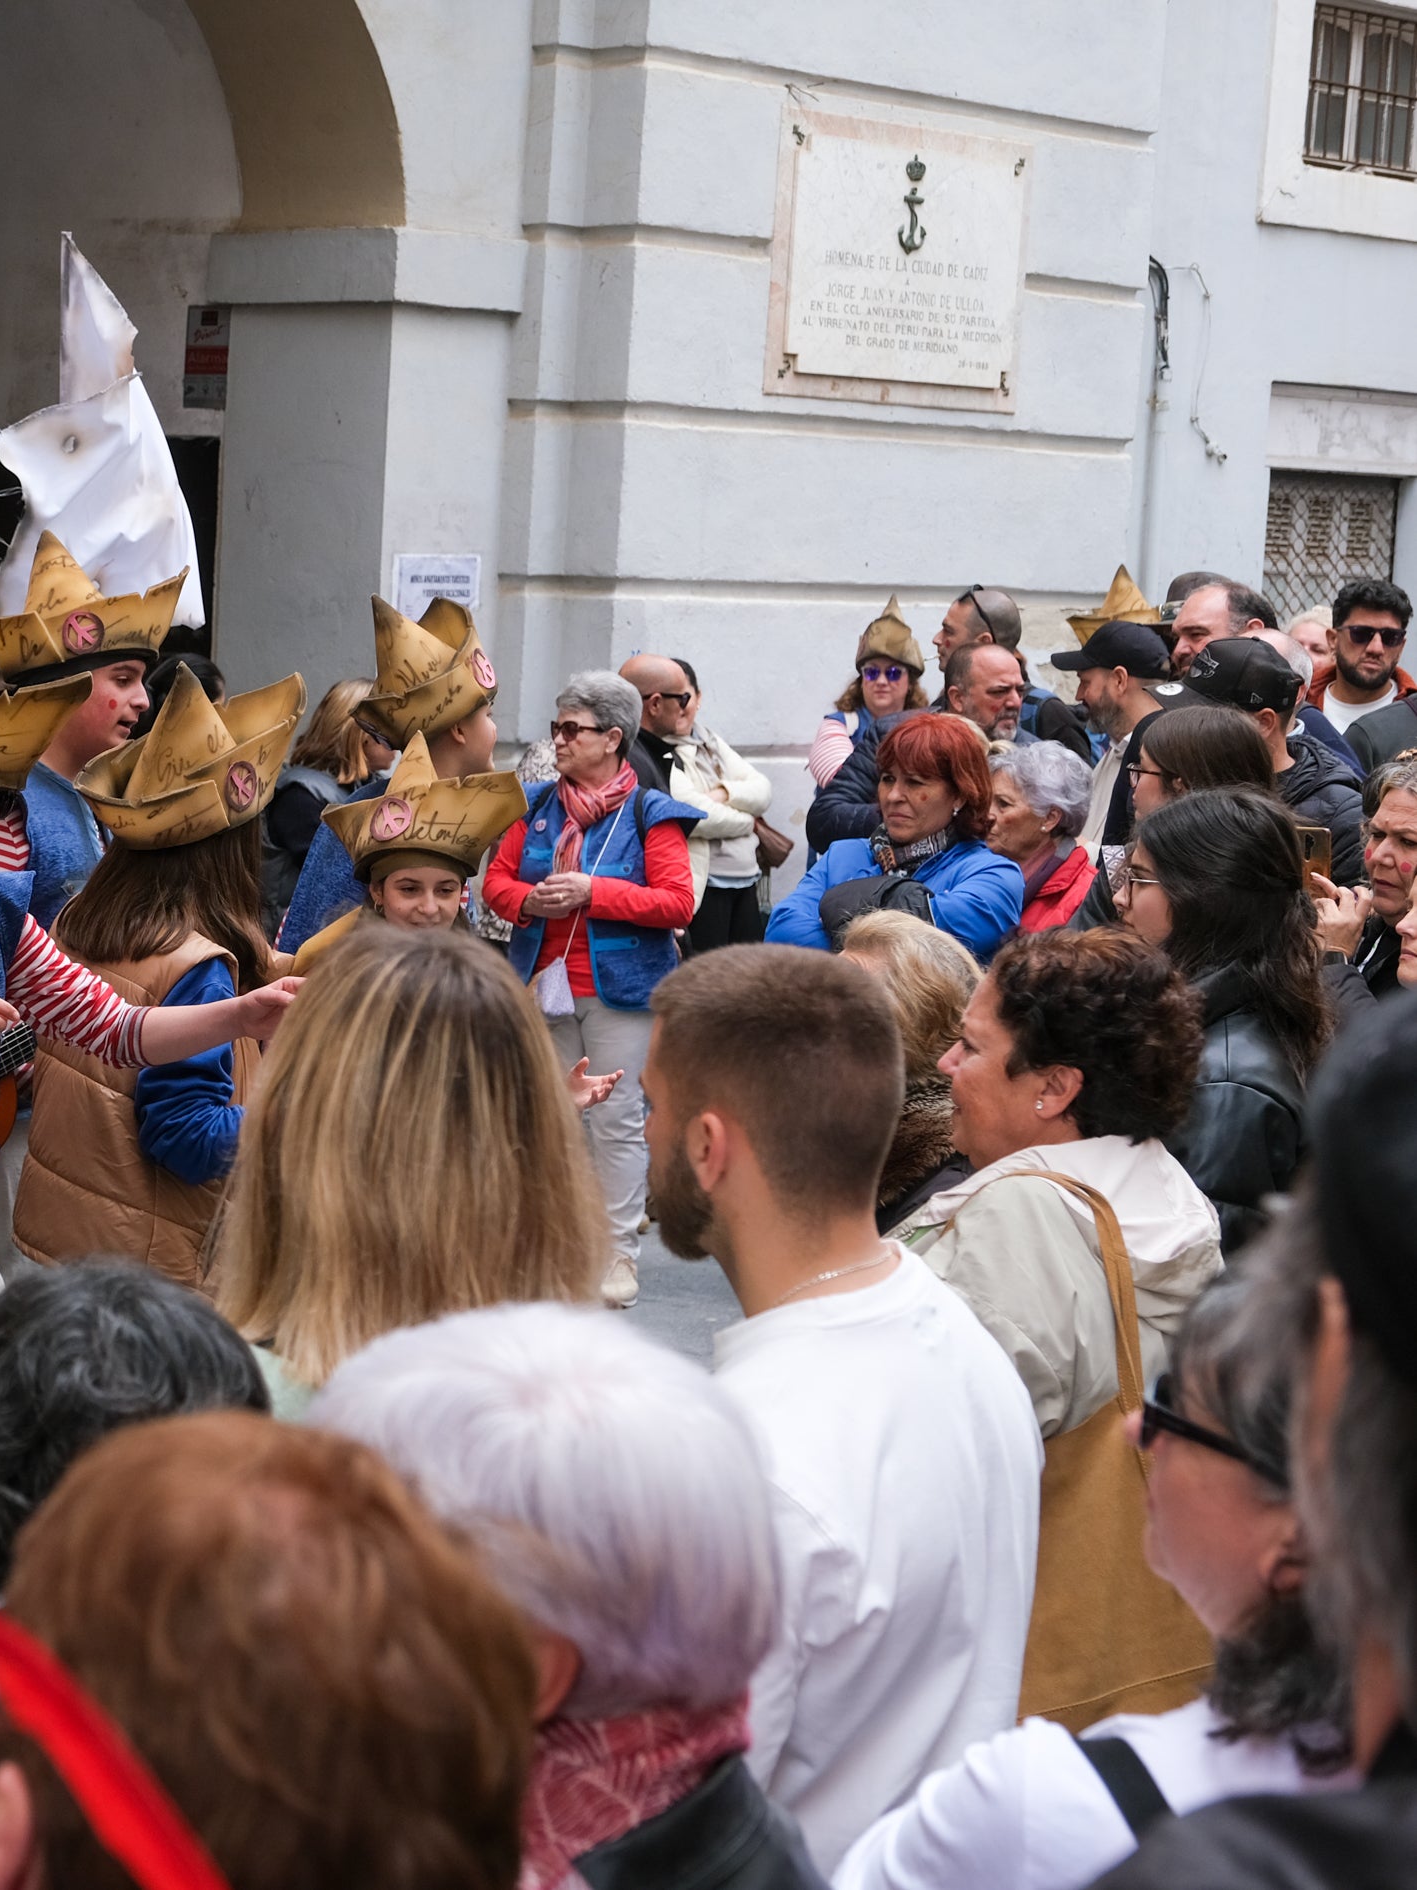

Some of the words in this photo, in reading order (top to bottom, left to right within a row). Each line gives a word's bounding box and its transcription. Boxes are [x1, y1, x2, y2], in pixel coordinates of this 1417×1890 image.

[825, 250, 875, 269] HOMENAJE
[879, 255, 892, 271] DE
[895, 256, 908, 273] LA
[912, 259, 944, 276] CIUDAD
[947, 263, 959, 278] DE
[826, 282, 856, 300] JORGE
[860, 286, 884, 302] JUAN
[888, 289, 895, 303] Y
[898, 291, 936, 308] ANTONIO
[940, 294, 952, 310] DE
[955, 296, 984, 313] ULLOA
[802, 316, 813, 327] AL
[873, 321, 891, 334] DEL
[922, 325, 944, 338] PARA
[947, 329, 959, 340] LA
[810, 300, 823, 311] EN
[827, 302, 839, 313] EL
[843, 303, 862, 316] CCL
[867, 306, 924, 322] ANIVERSARIO
[928, 311, 940, 323] DE
[944, 311, 956, 324] SU
[960, 313, 996, 329] PARTIDA
[845, 335, 862, 346] DEL
[866, 336, 896, 350] GRADO
[899, 339, 910, 350] DE
[913, 340, 959, 354] MERIDIANO
